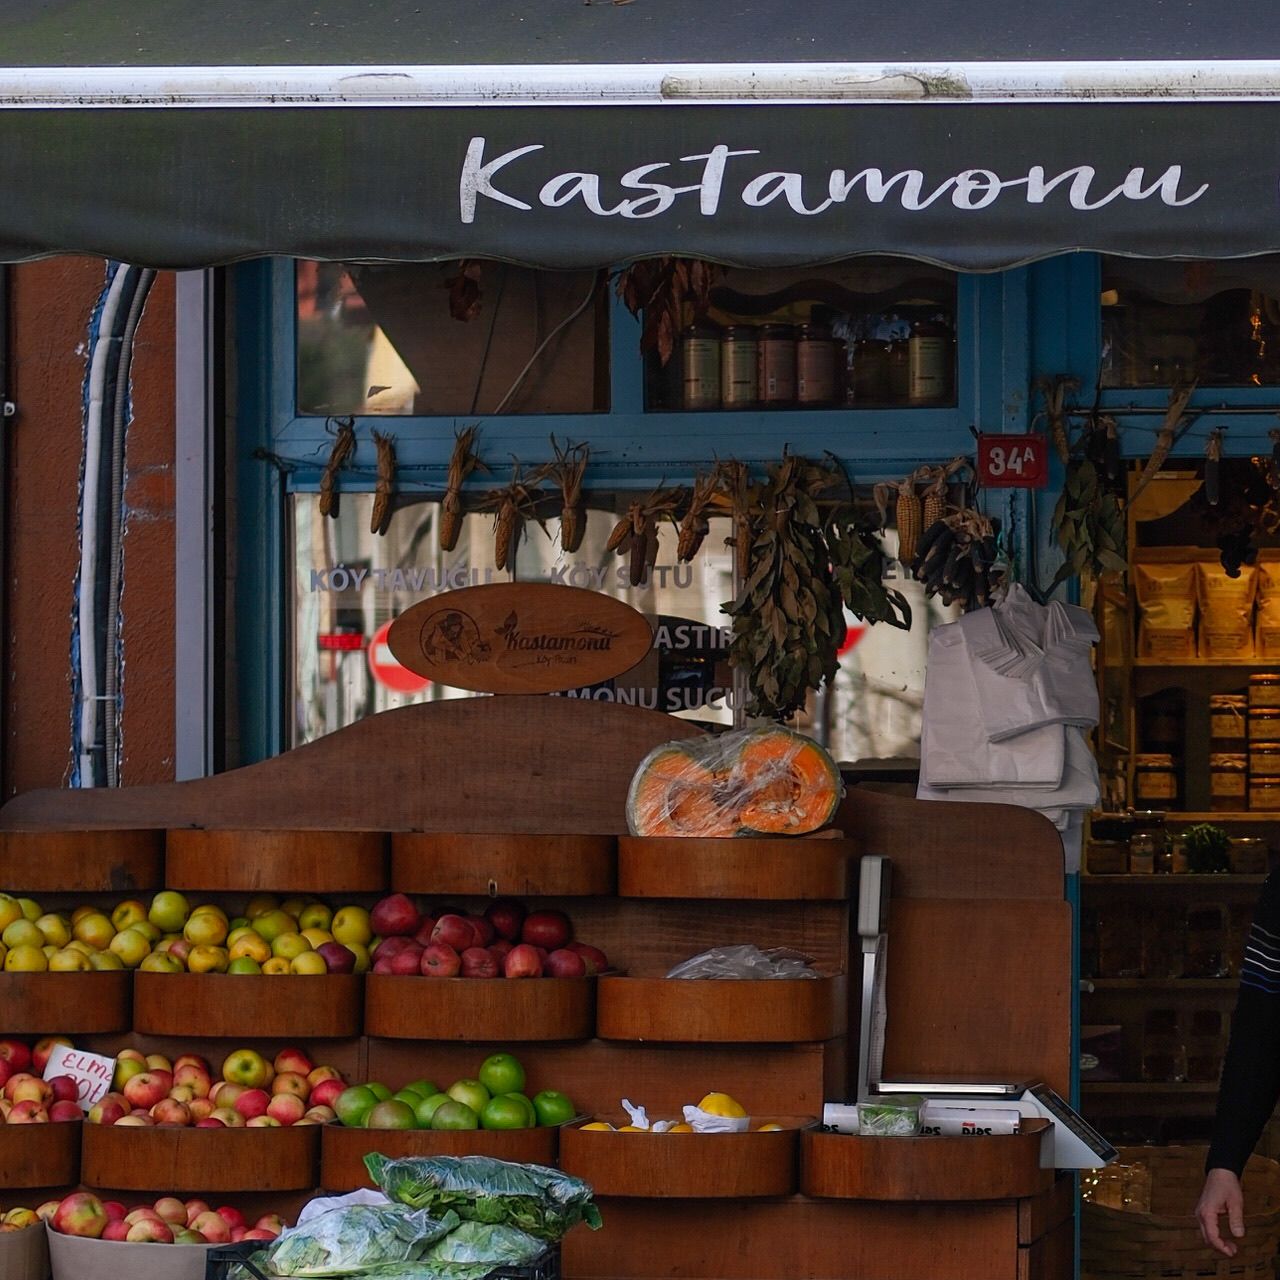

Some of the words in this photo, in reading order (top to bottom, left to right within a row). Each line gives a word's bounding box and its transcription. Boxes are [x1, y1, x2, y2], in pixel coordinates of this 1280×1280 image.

[460, 136, 1210, 224] Kastamonu
[311, 563, 368, 593] KÖY
[551, 561, 609, 589] KÖY
[506, 630, 612, 651] Kastamonu
